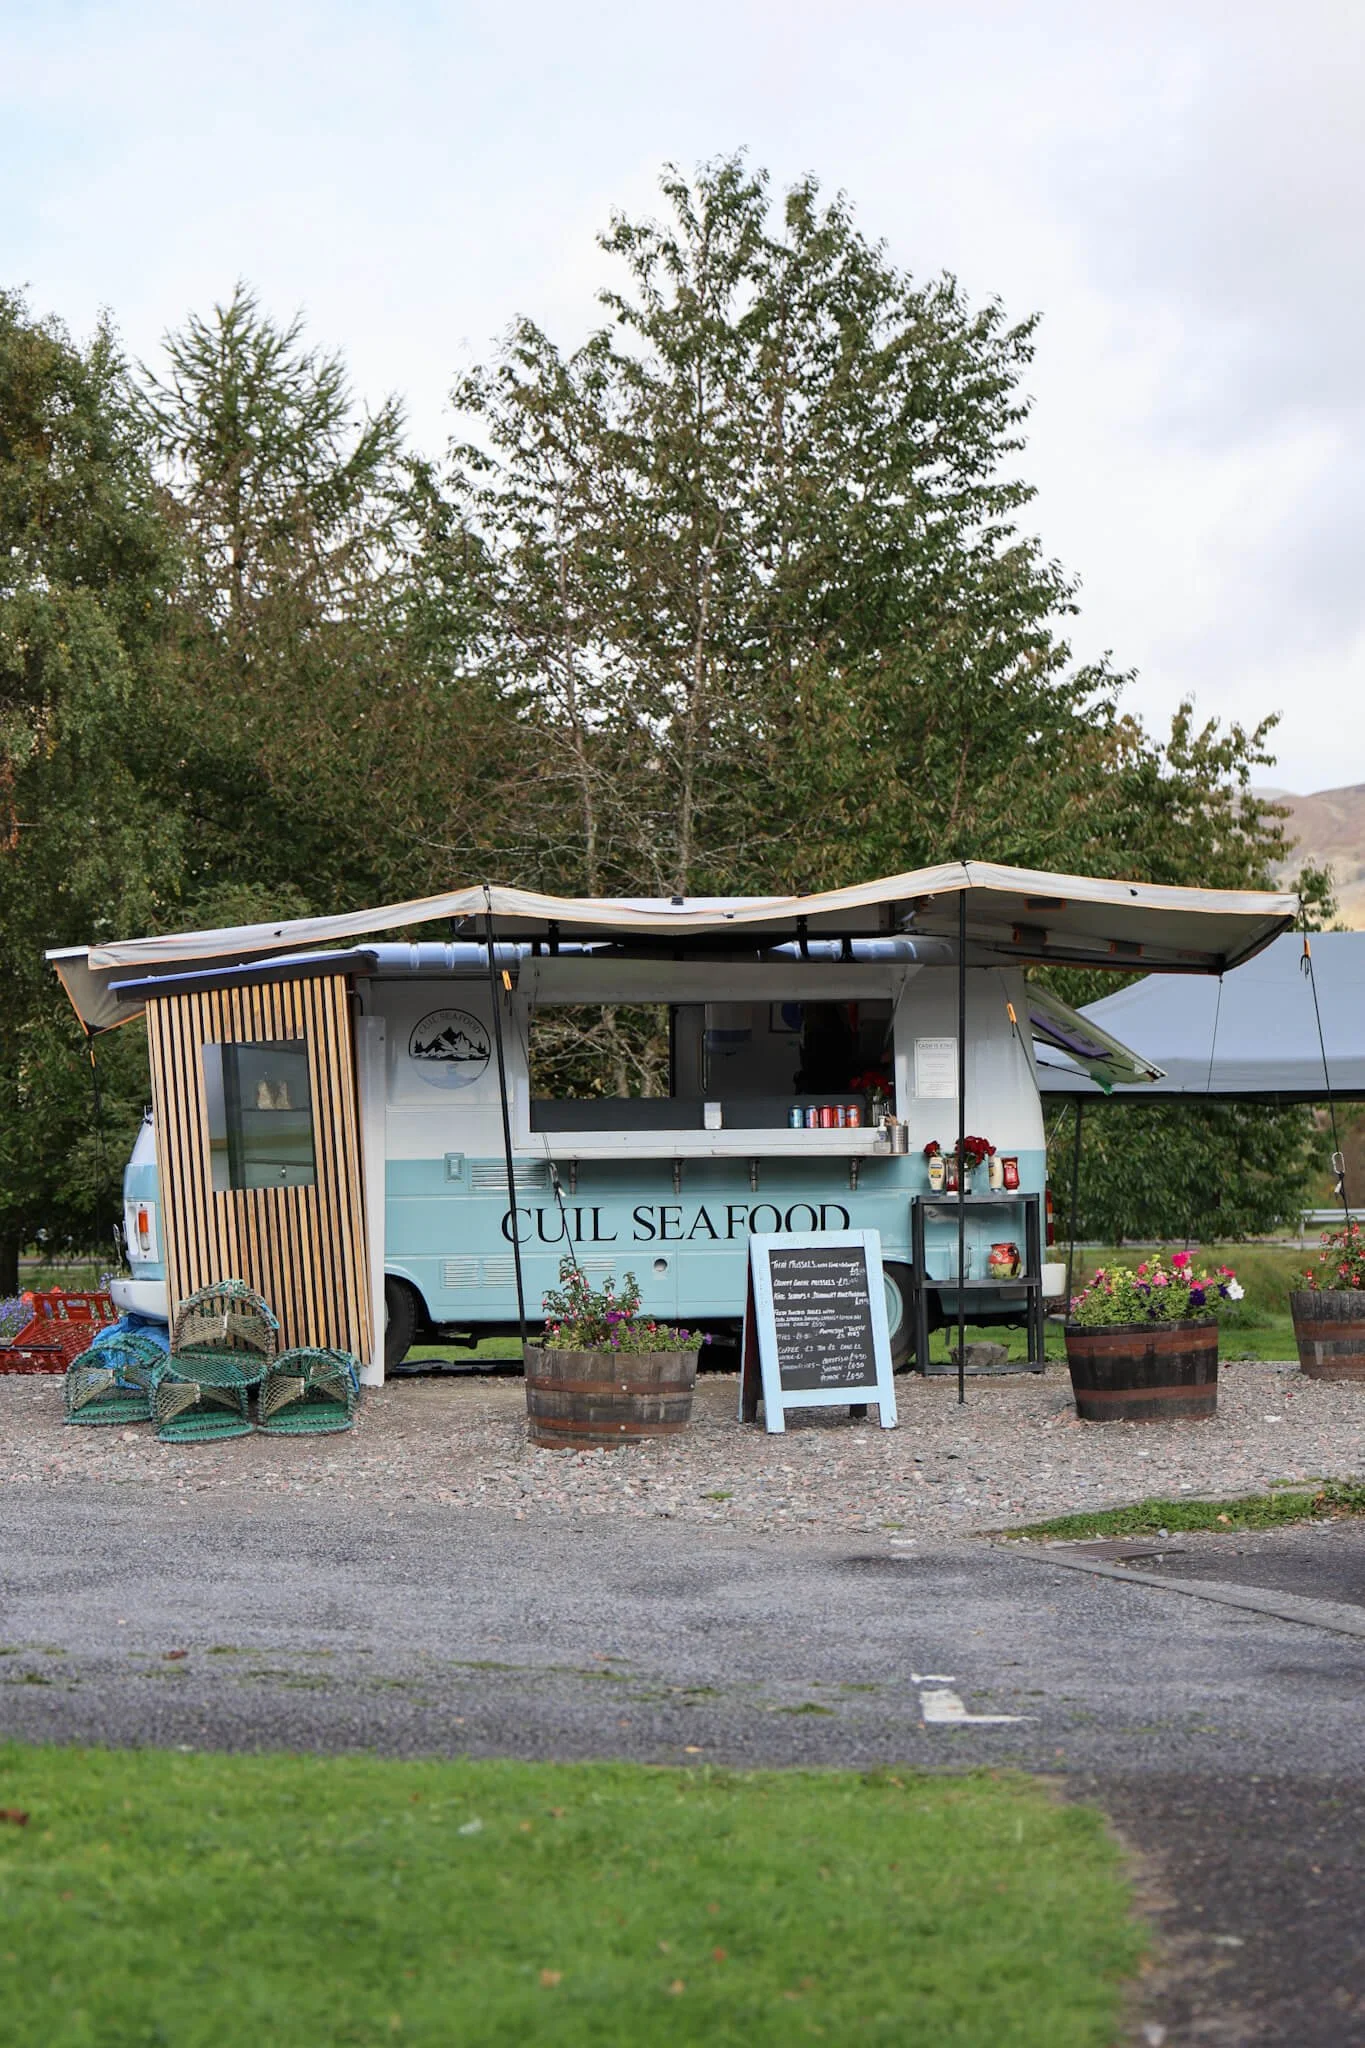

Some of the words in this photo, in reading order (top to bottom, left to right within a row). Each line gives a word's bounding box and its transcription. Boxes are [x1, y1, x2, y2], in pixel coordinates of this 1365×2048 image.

[418, 1015, 438, 1034] CUIL
[439, 1012, 481, 1034] SEAFOOD
[501, 1207, 618, 1244] CUIL
[633, 1203, 850, 1241] SEAFOOD
